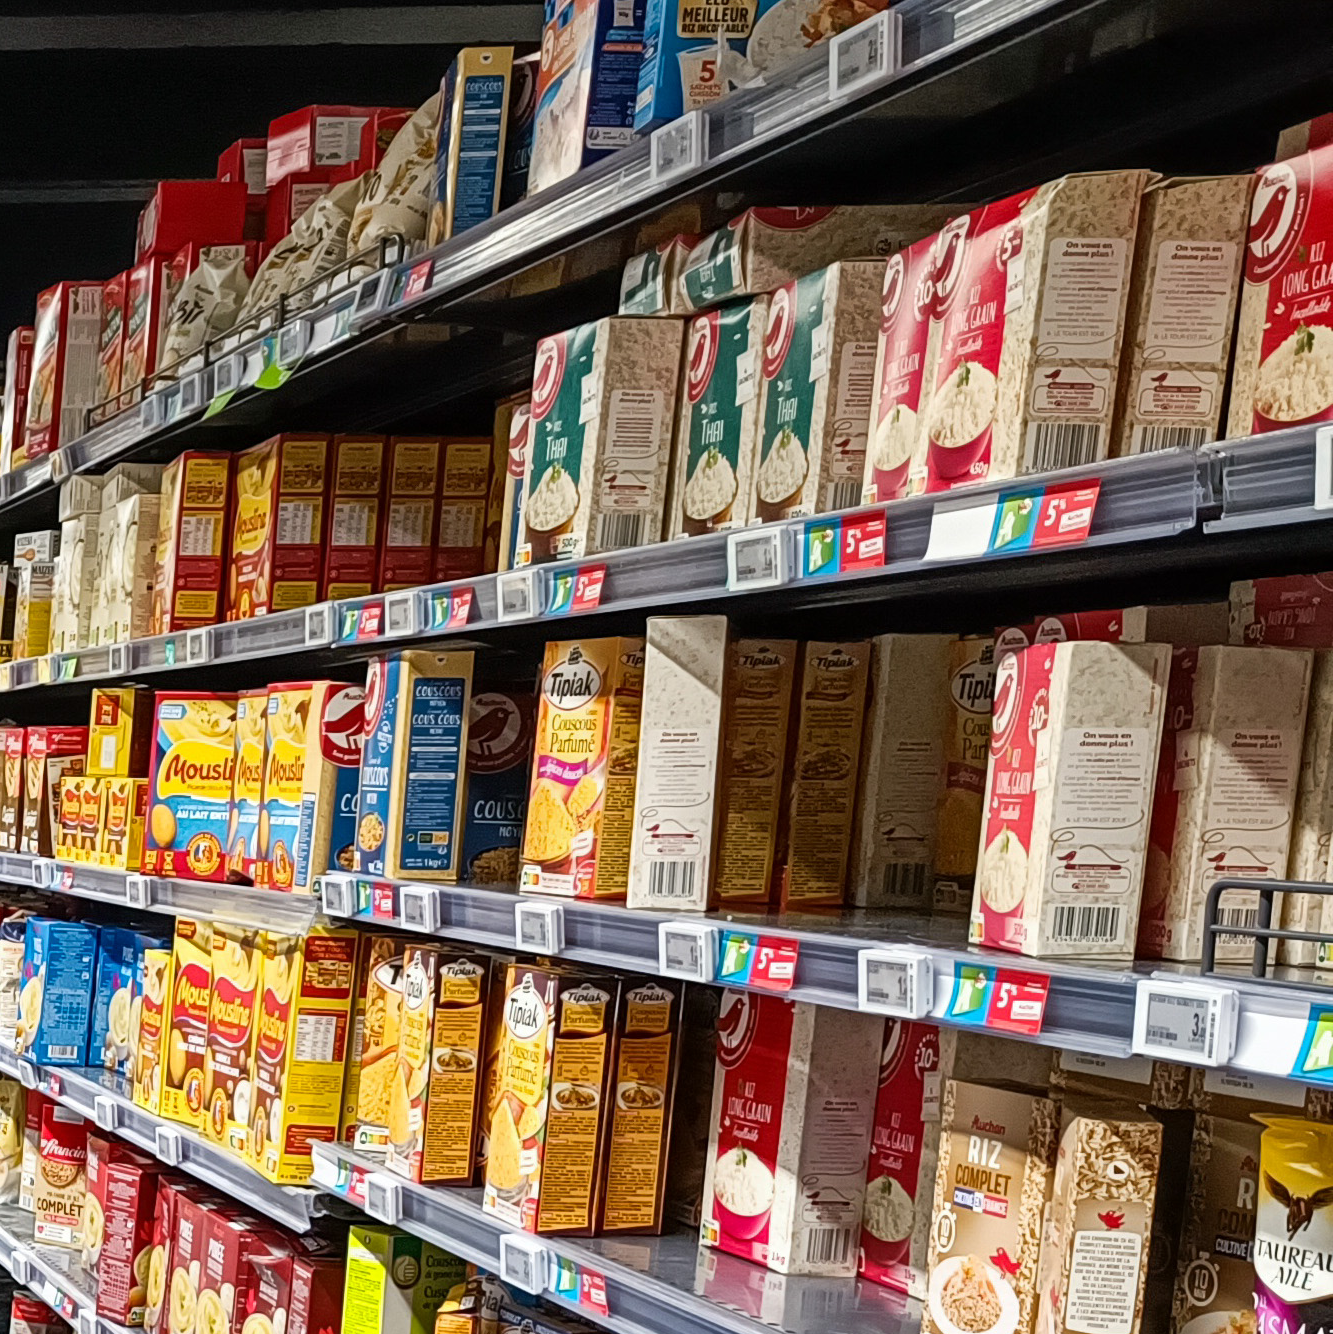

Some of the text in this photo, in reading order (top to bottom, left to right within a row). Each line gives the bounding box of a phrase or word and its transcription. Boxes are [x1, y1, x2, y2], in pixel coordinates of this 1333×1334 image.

[684, 7, 748, 22] MEILLEUR
[682, 23, 695, 33] RIZ
[700, 60, 716, 83] 5
[1310, 241, 1323, 260] RIZ
[1282, 269, 1309, 297] LONG
[971, 301, 996, 330] GRAIN
[742, 654, 781, 667] Tipiak
[816, 656, 854, 669] Tipiak
[416, 686, 461, 696] COUSCOUS
[548, 669, 594, 698] Tipiak
[413, 714, 460, 724] COUS COUS
[552, 715, 596, 731] Couscous
[550, 733, 594, 753] Parfumé
[446, 967, 477, 976] Tipiak
[568, 993, 602, 1002] Tipiak
[633, 993, 666, 1002] Tipiak
[510, 998, 538, 1029] Tipiak
[746, 1104, 771, 1123] GRAIN
[971, 1115, 1005, 1134] Auchan
[967, 1136, 1000, 1169] RIZ
[955, 1164, 1011, 1196] COMPLET
[37, 1199, 83, 1217] COMPLET
[1194, 1269, 1208, 1284] 10
[1272, 1266, 1314, 1291] AILÉ
